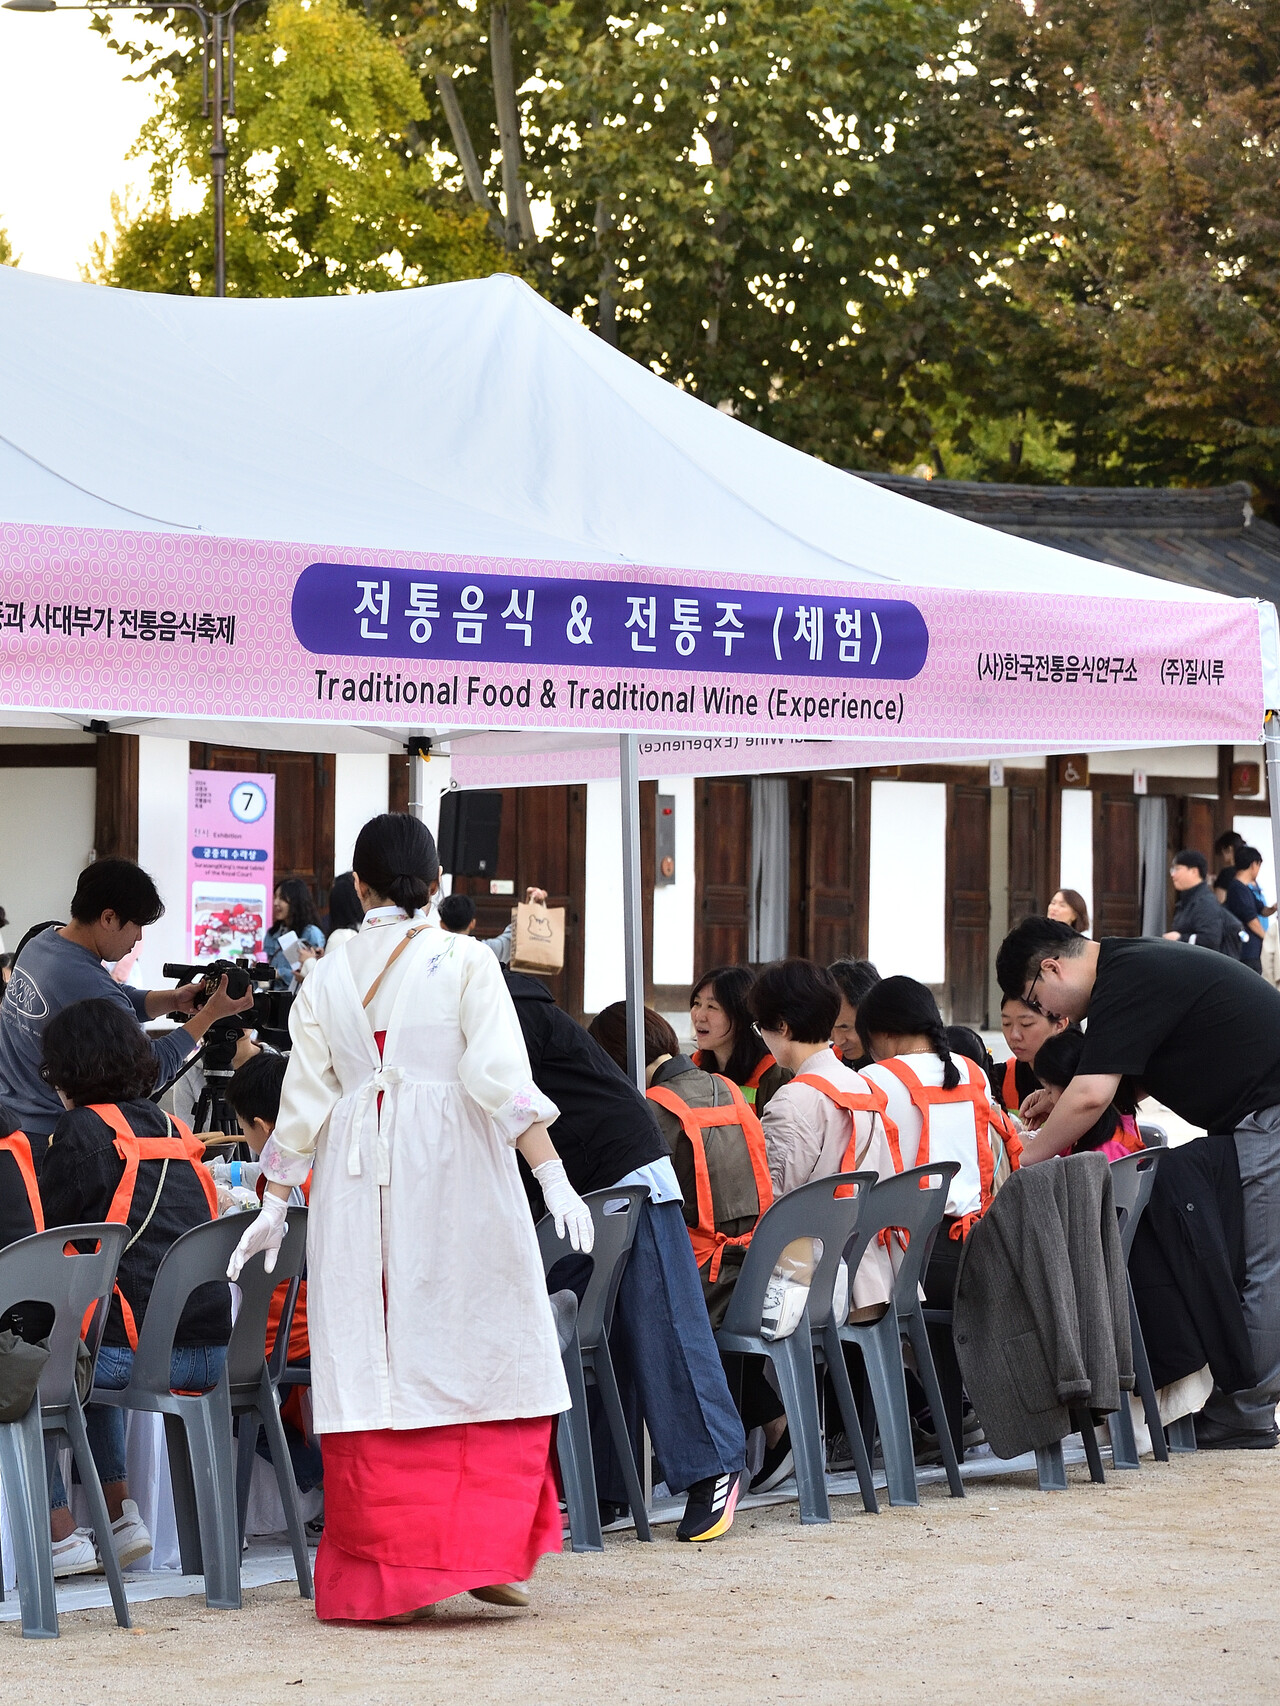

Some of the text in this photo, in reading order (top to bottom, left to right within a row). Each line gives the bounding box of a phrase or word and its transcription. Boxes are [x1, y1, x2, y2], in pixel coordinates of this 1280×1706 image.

[30, 603, 115, 638] 사대부가
[119, 608, 236, 645] 전통음식축제
[354, 580, 882, 665] 전통음식 & 전통주 (체험)
[976, 652, 1225, 686] (사)한국전통음식연구소 (주)질시루
[315, 669, 904, 724] Traditional Food & Traditional Wine (Experience)
[242, 792, 254, 811] 7
